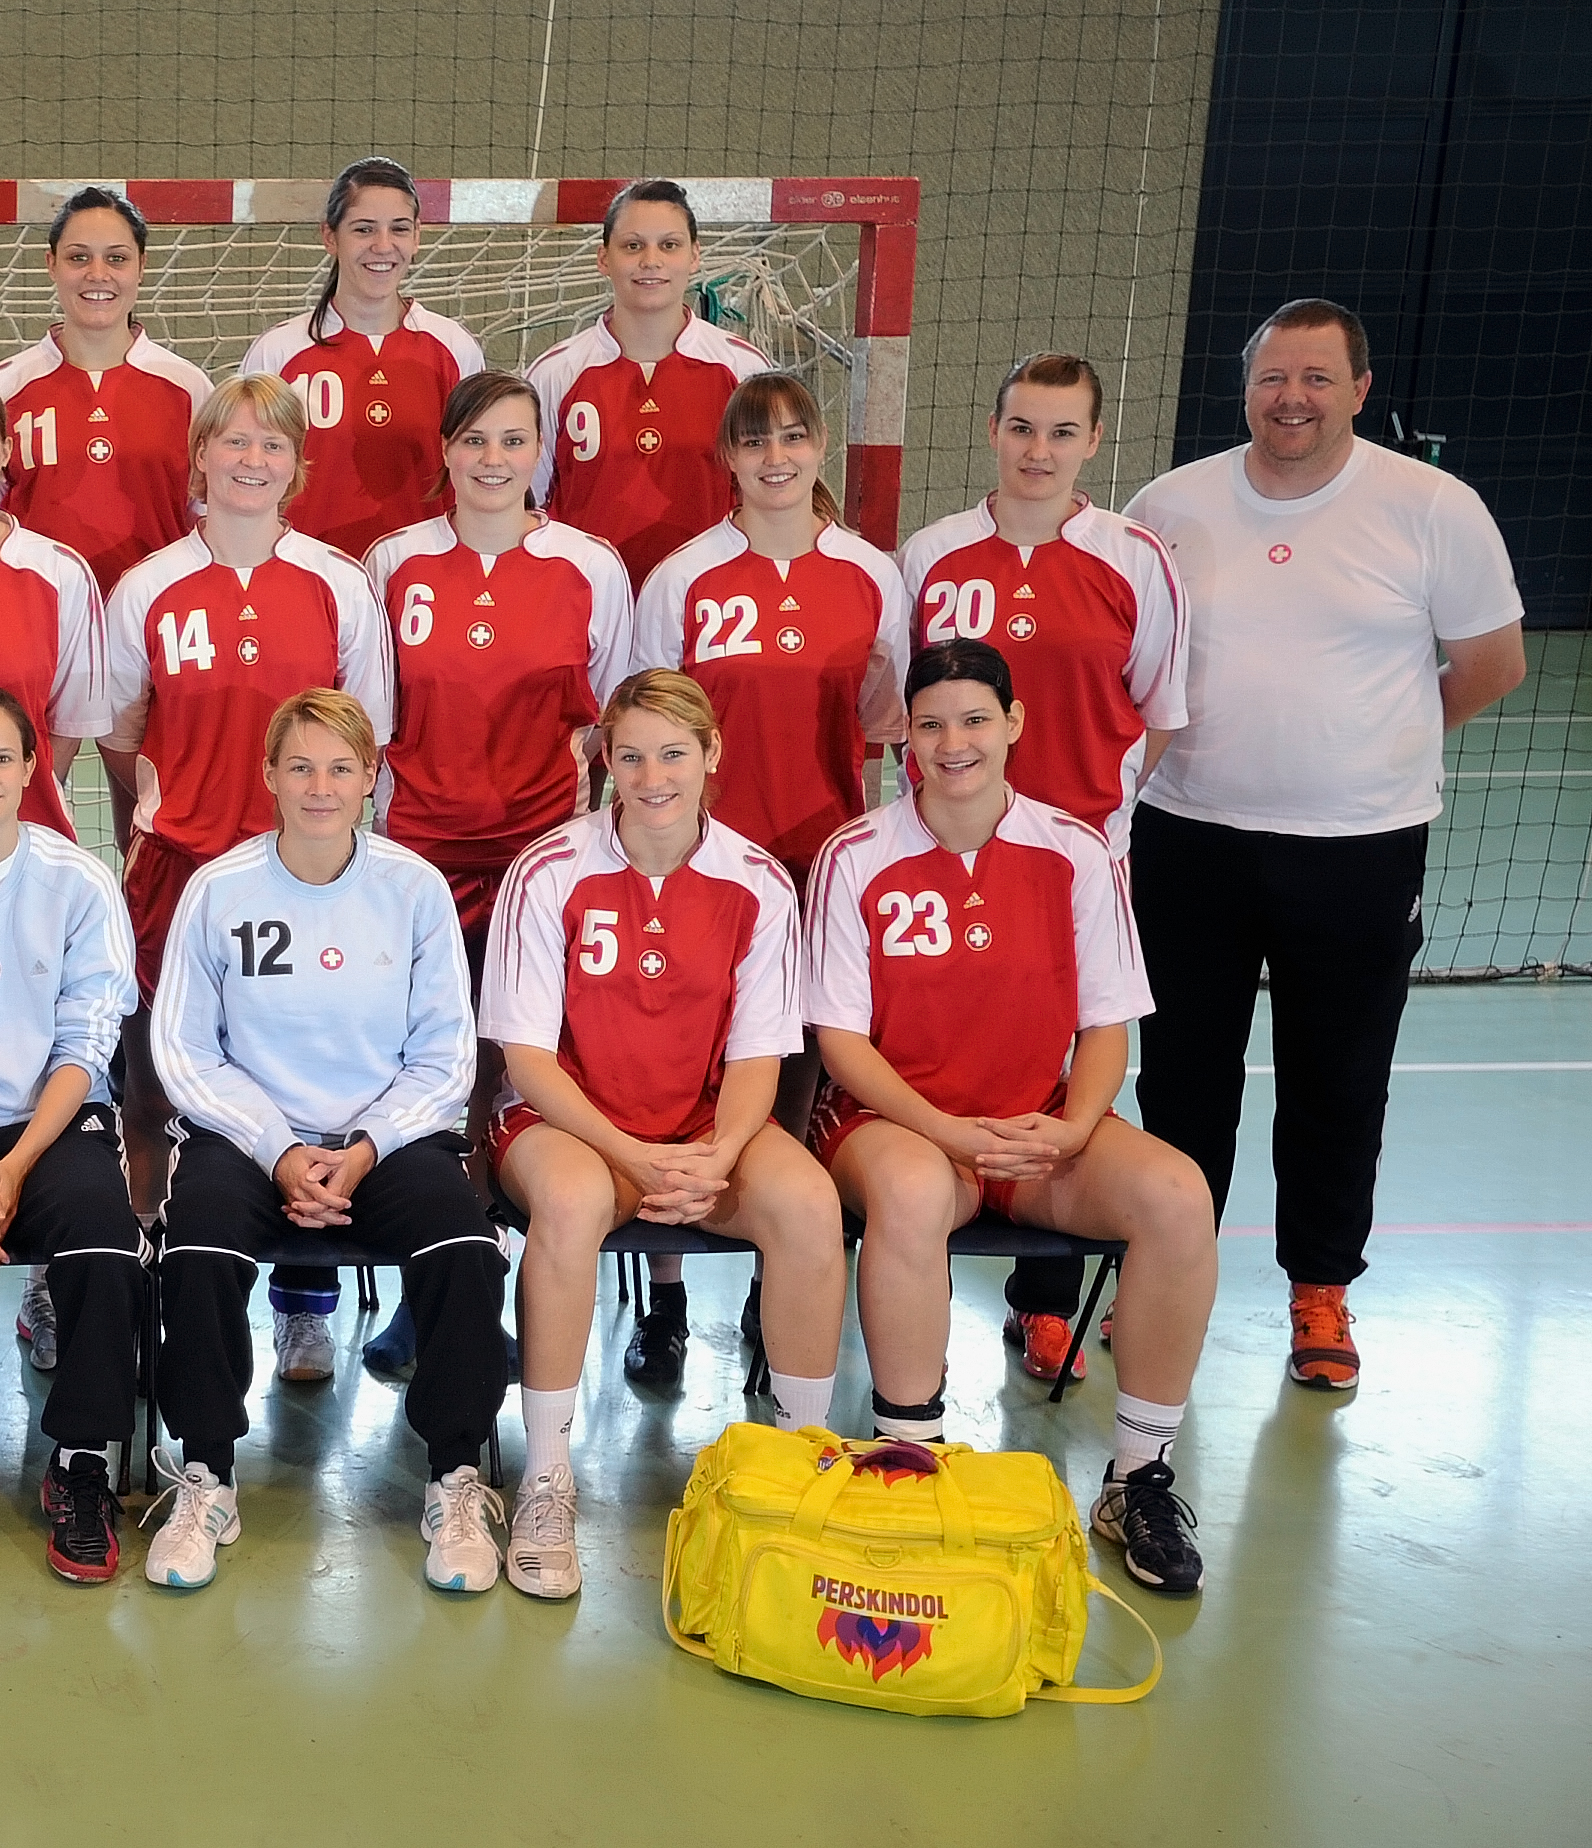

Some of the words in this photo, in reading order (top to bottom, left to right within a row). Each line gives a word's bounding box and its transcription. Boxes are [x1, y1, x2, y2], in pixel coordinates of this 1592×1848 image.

[291, 371, 343, 430] 10
[566, 401, 600, 462] 9
[13, 407, 58, 470] 11
[400, 584, 434, 646] 6
[695, 595, 762, 663] 22
[924, 578, 995, 641] 20
[157, 609, 216, 675] 14
[231, 921, 293, 977] 12
[579, 909, 618, 976] 5
[878, 891, 952, 957] 23
[811, 1573, 949, 1619] PERSKINDOL
